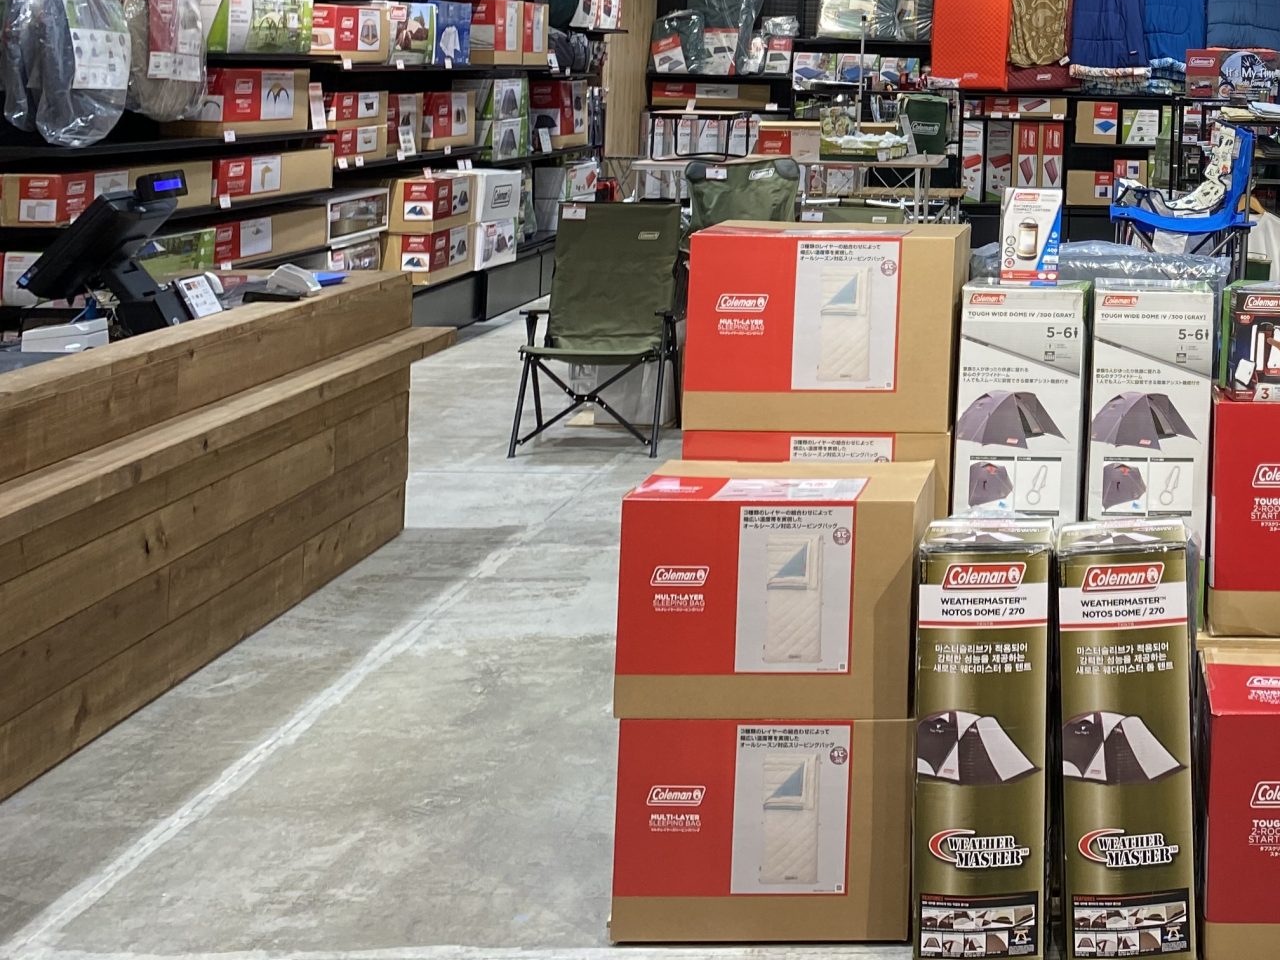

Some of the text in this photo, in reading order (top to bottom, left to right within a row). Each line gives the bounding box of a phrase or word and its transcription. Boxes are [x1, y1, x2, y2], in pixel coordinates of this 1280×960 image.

[721, 296, 757, 307] Coleman
[1248, 297, 1278, 307] Coleman
[1261, 387, 1270, 400] 3
[1251, 512, 1278, 520] START
[656, 568, 696, 581] Coleman
[949, 567, 1007, 585] Coleman
[1088, 568, 1146, 587] Coleman
[941, 608, 972, 616] NOTOS
[974, 608, 1001, 616] DOME
[1009, 607, 1025, 615] 270
[1082, 610, 1113, 618] NOTOS
[1114, 609, 1141, 617] DOME
[1149, 607, 1165, 615] 270
[652, 788, 692, 800] Coleman
[947, 835, 1015, 851] WEATHER
[1097, 833, 1165, 851] WEATHER
[1248, 835, 1280, 844] START
